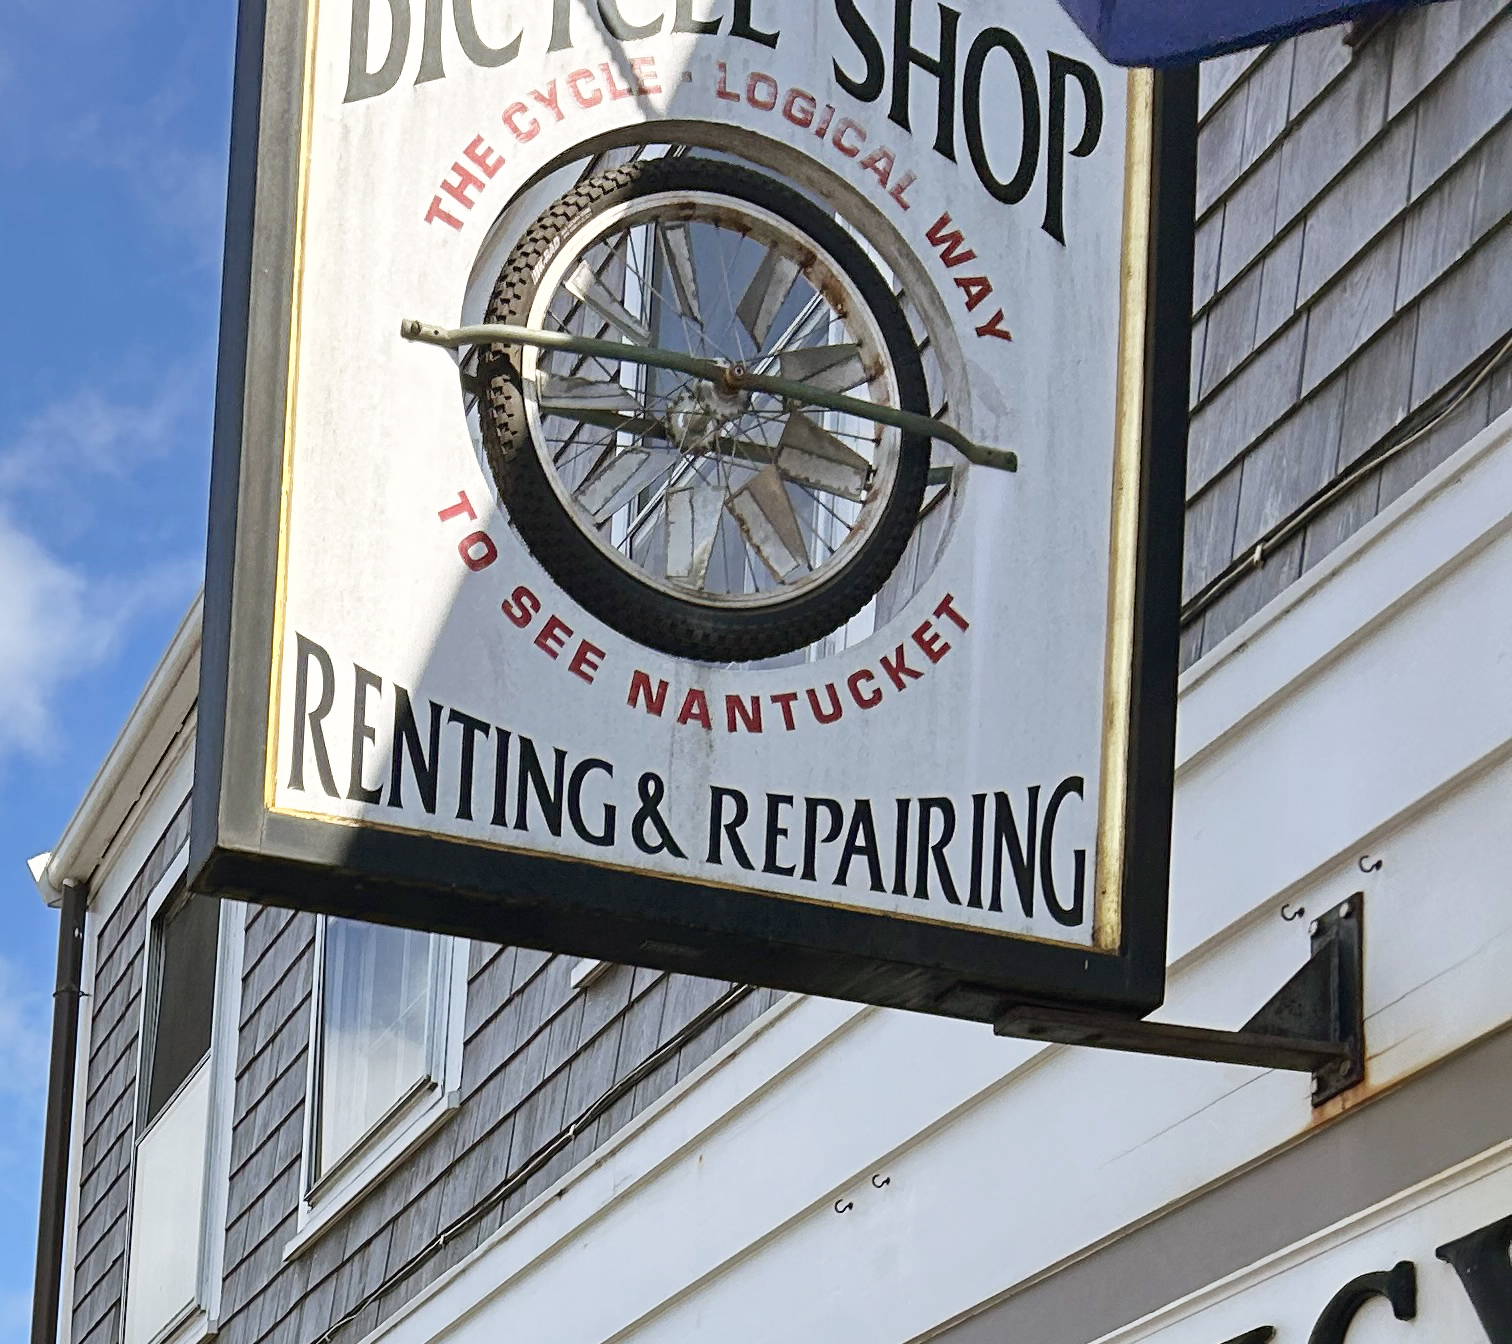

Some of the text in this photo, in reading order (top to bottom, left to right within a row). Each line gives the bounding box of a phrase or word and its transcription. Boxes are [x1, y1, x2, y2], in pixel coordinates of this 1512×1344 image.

[424, 133, 505, 233] THE
[502, 56, 662, 143] CYCLE
[716, 61, 917, 211] LOGICAL
[925, 211, 1014, 342] WAY
[832, 0, 1104, 247] SHOP
[437, 489, 970, 734] TO SEE NANTUCKET
[287, 631, 1086, 927] RENTING & REPAIRING
